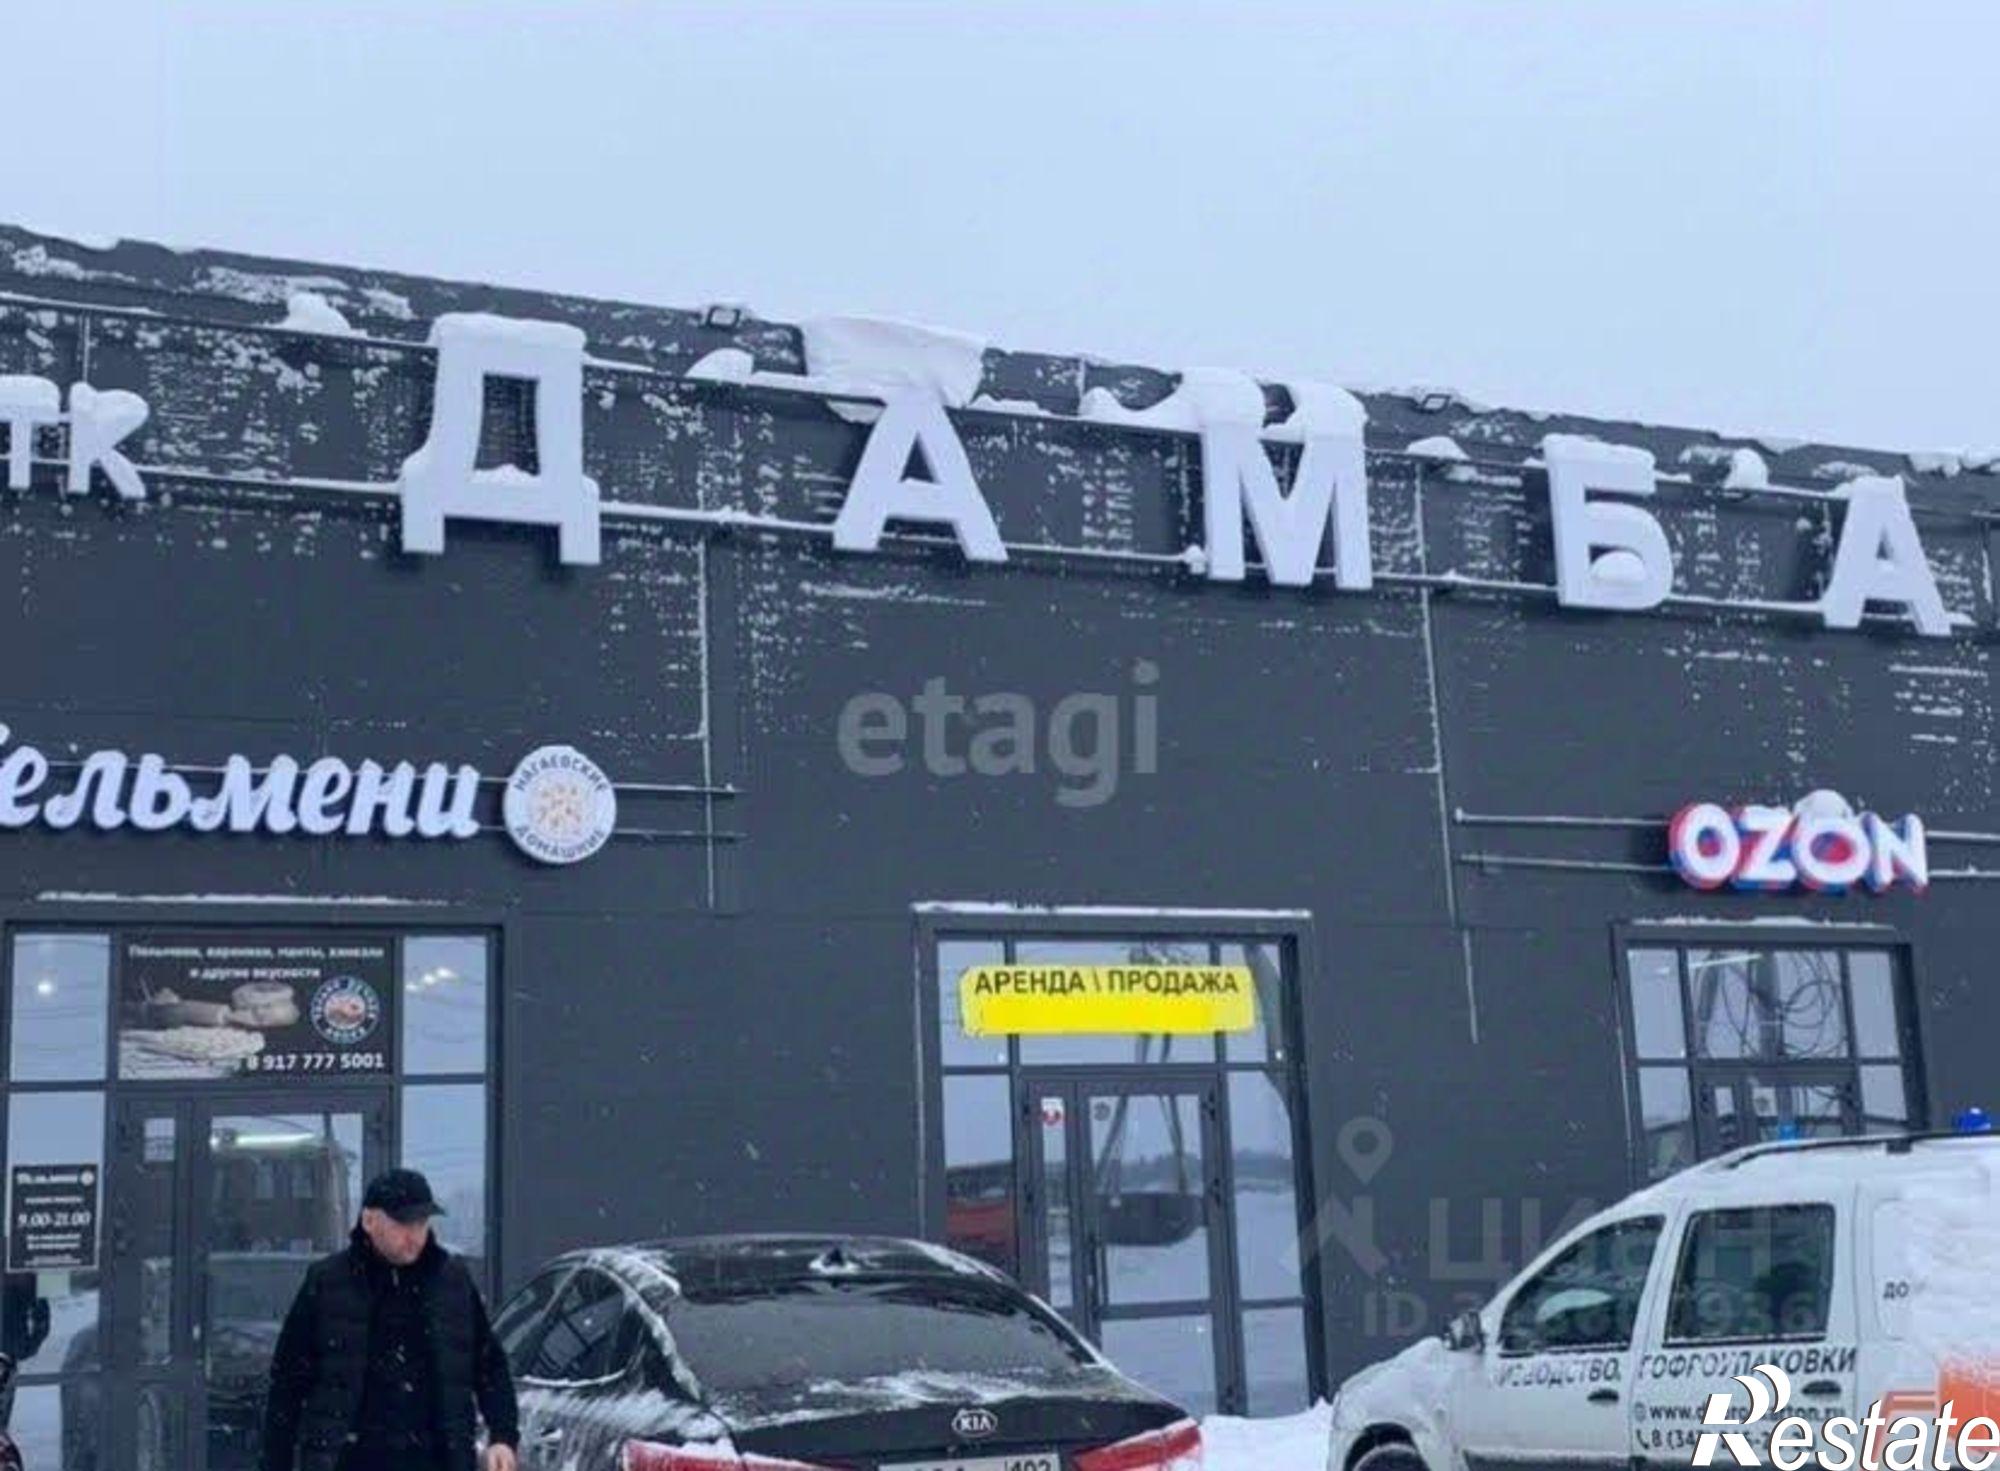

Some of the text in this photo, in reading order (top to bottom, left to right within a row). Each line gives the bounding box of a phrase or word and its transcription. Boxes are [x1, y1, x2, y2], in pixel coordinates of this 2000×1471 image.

[401, 313, 1952, 636] ДАМБА
[0, 724, 480, 838] ельмени
[1669, 800, 1928, 894] OZON
[975, 970, 1085, 994] АРЕНДА
[1108, 971, 1239, 995] ПРОДАЖА
[263, 1053, 295, 1070] 917
[303, 1053, 335, 1069] 777
[341, 1052, 385, 1068] 5001
[960, 1415, 992, 1431] KIA
